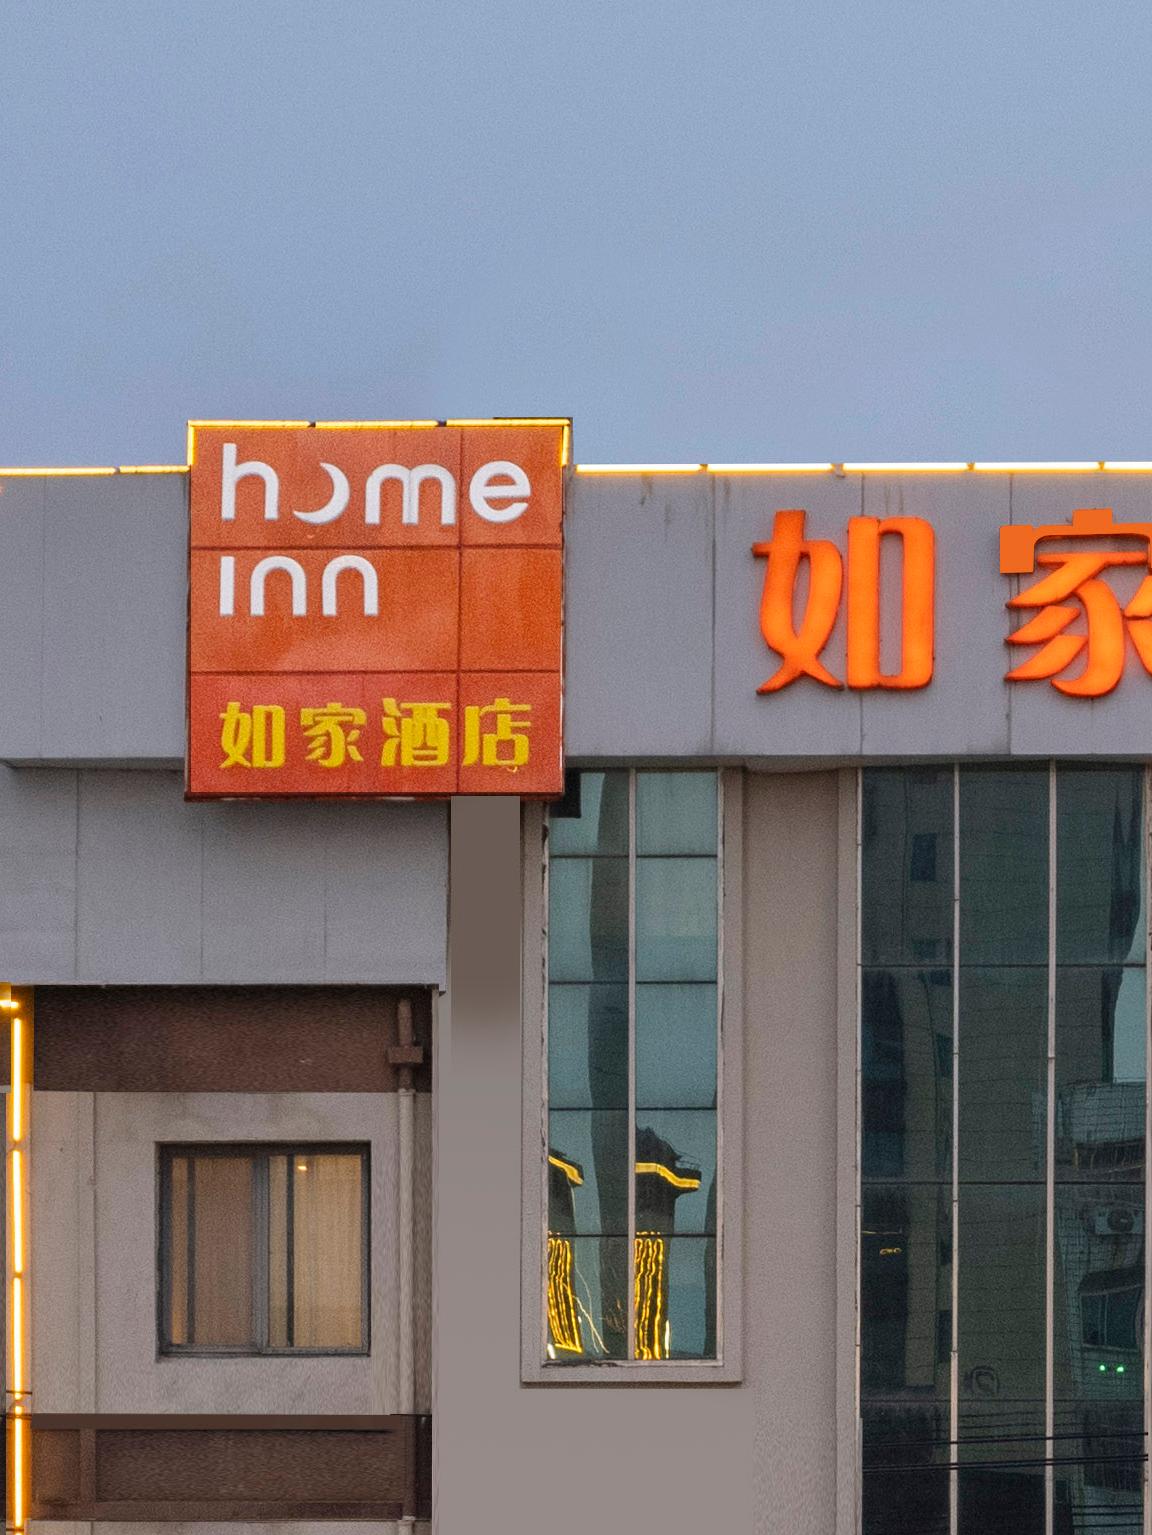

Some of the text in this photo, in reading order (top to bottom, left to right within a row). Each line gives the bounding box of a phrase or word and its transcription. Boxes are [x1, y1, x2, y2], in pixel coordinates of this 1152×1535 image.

[220, 442, 532, 526] home
[218, 554, 379, 617] inn
[218, 697, 532, 769] 如家酒店
